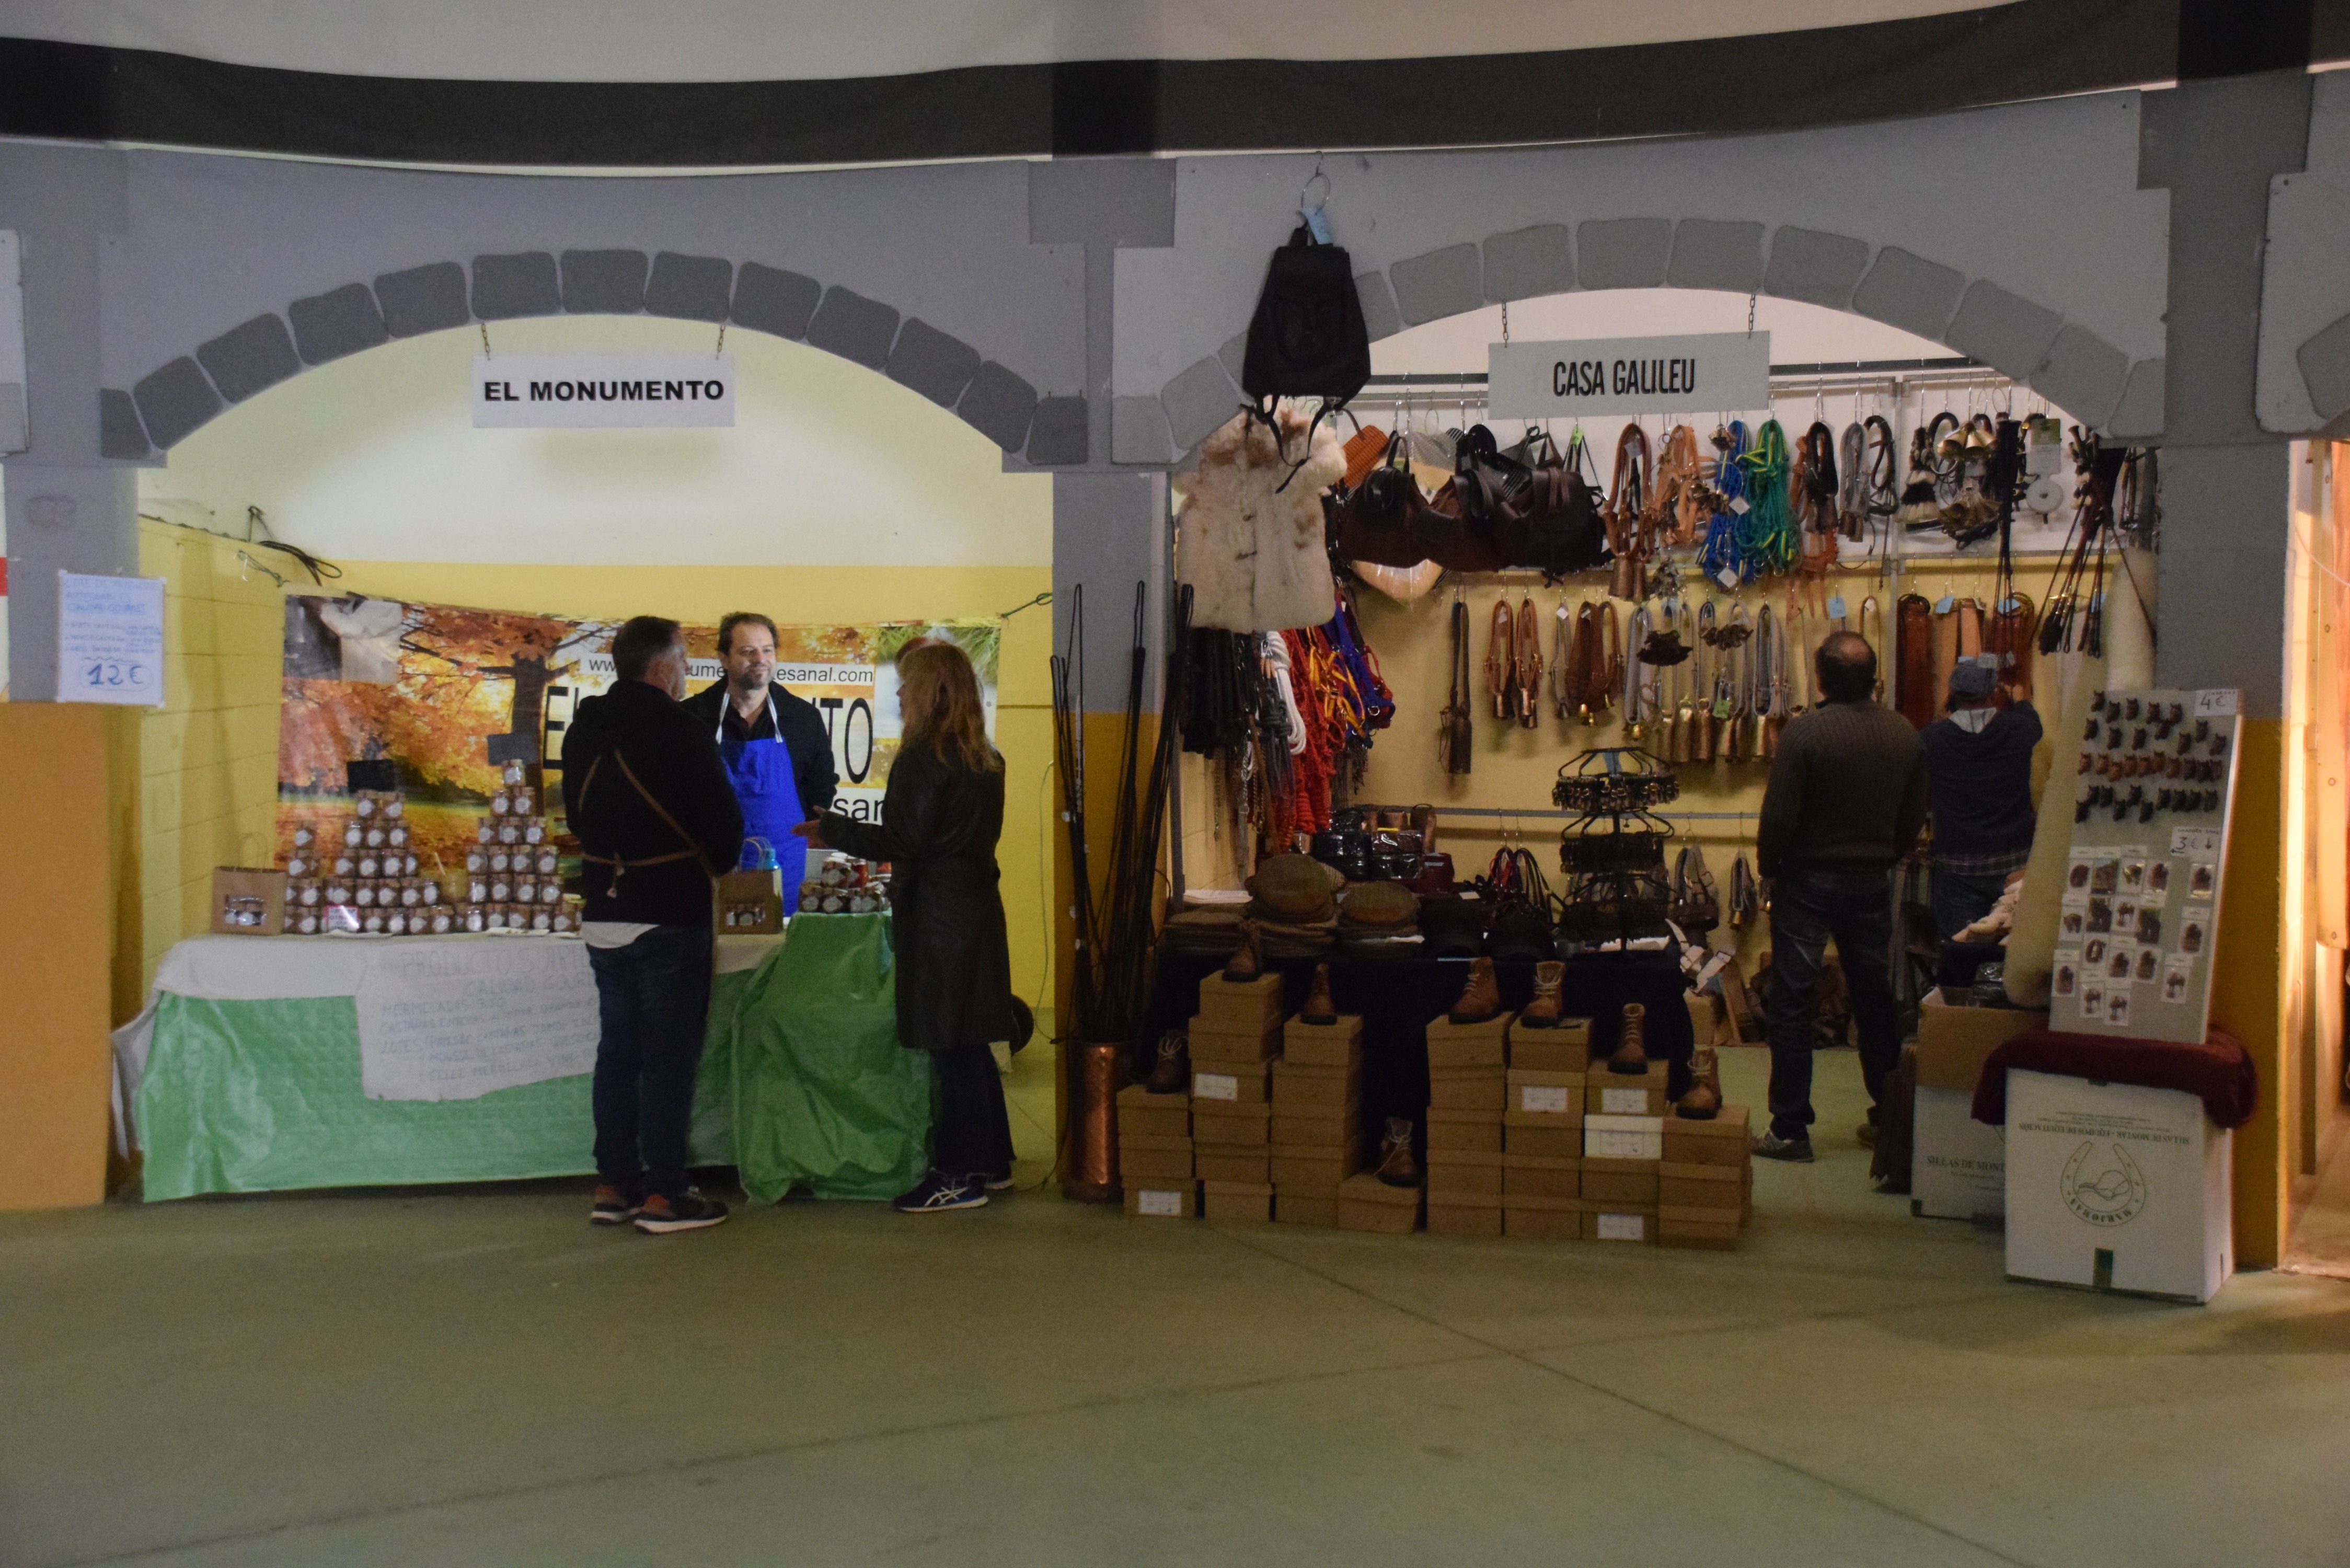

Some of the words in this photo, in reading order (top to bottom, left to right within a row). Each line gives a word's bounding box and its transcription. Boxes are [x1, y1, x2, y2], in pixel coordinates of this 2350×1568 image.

[484, 382, 520, 401] EL
[530, 380, 724, 401] MONUMENTO
[1553, 361, 1605, 397] CASA
[1612, 359, 1695, 396] GALILEU
[400, 947, 534, 978] PRODUCTOS
[1976, 1161, 2006, 1172] MONT
